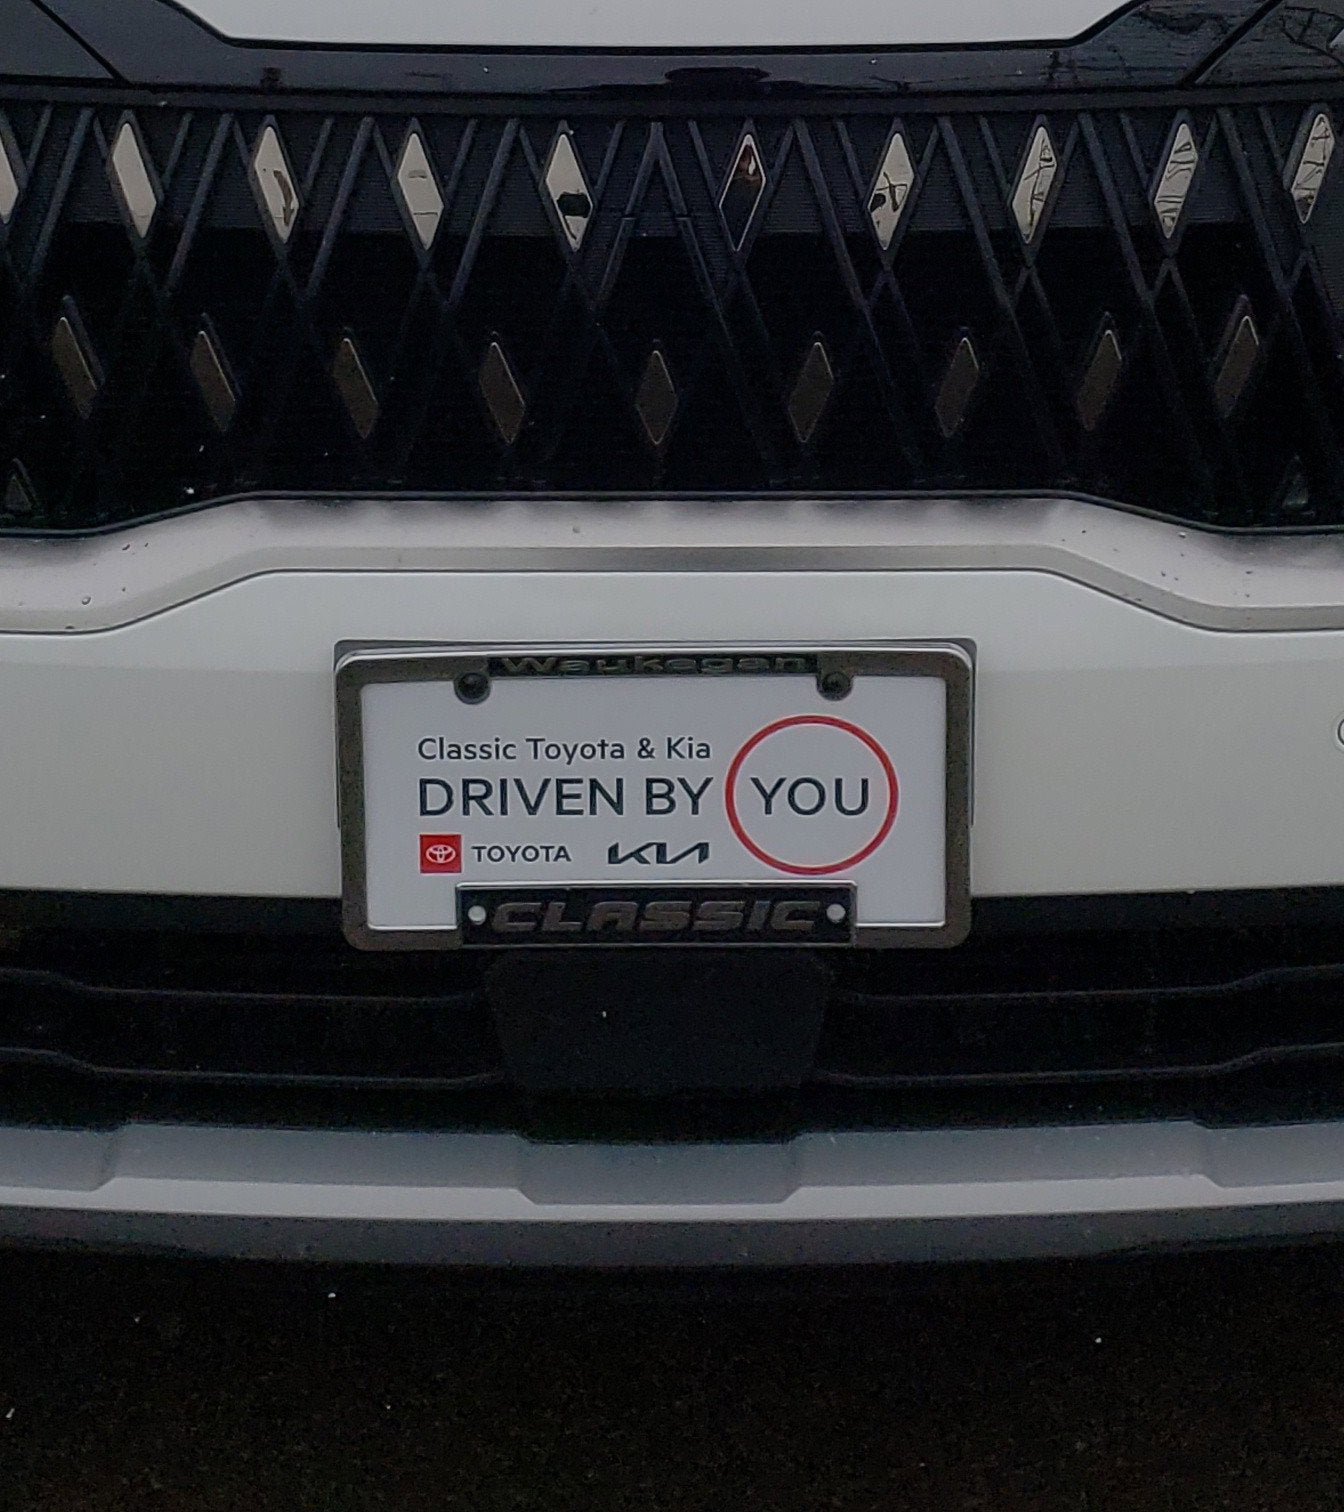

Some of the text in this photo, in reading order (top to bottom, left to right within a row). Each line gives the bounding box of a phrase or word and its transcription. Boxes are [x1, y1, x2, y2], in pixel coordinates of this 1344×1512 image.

[417, 736, 712, 768] Classic Toyota & Kia
[419, 777, 871, 817] DRIVEN BY YOU
[472, 841, 710, 866] TOYOTA KIA
[490, 900, 821, 932] CLASSIC
